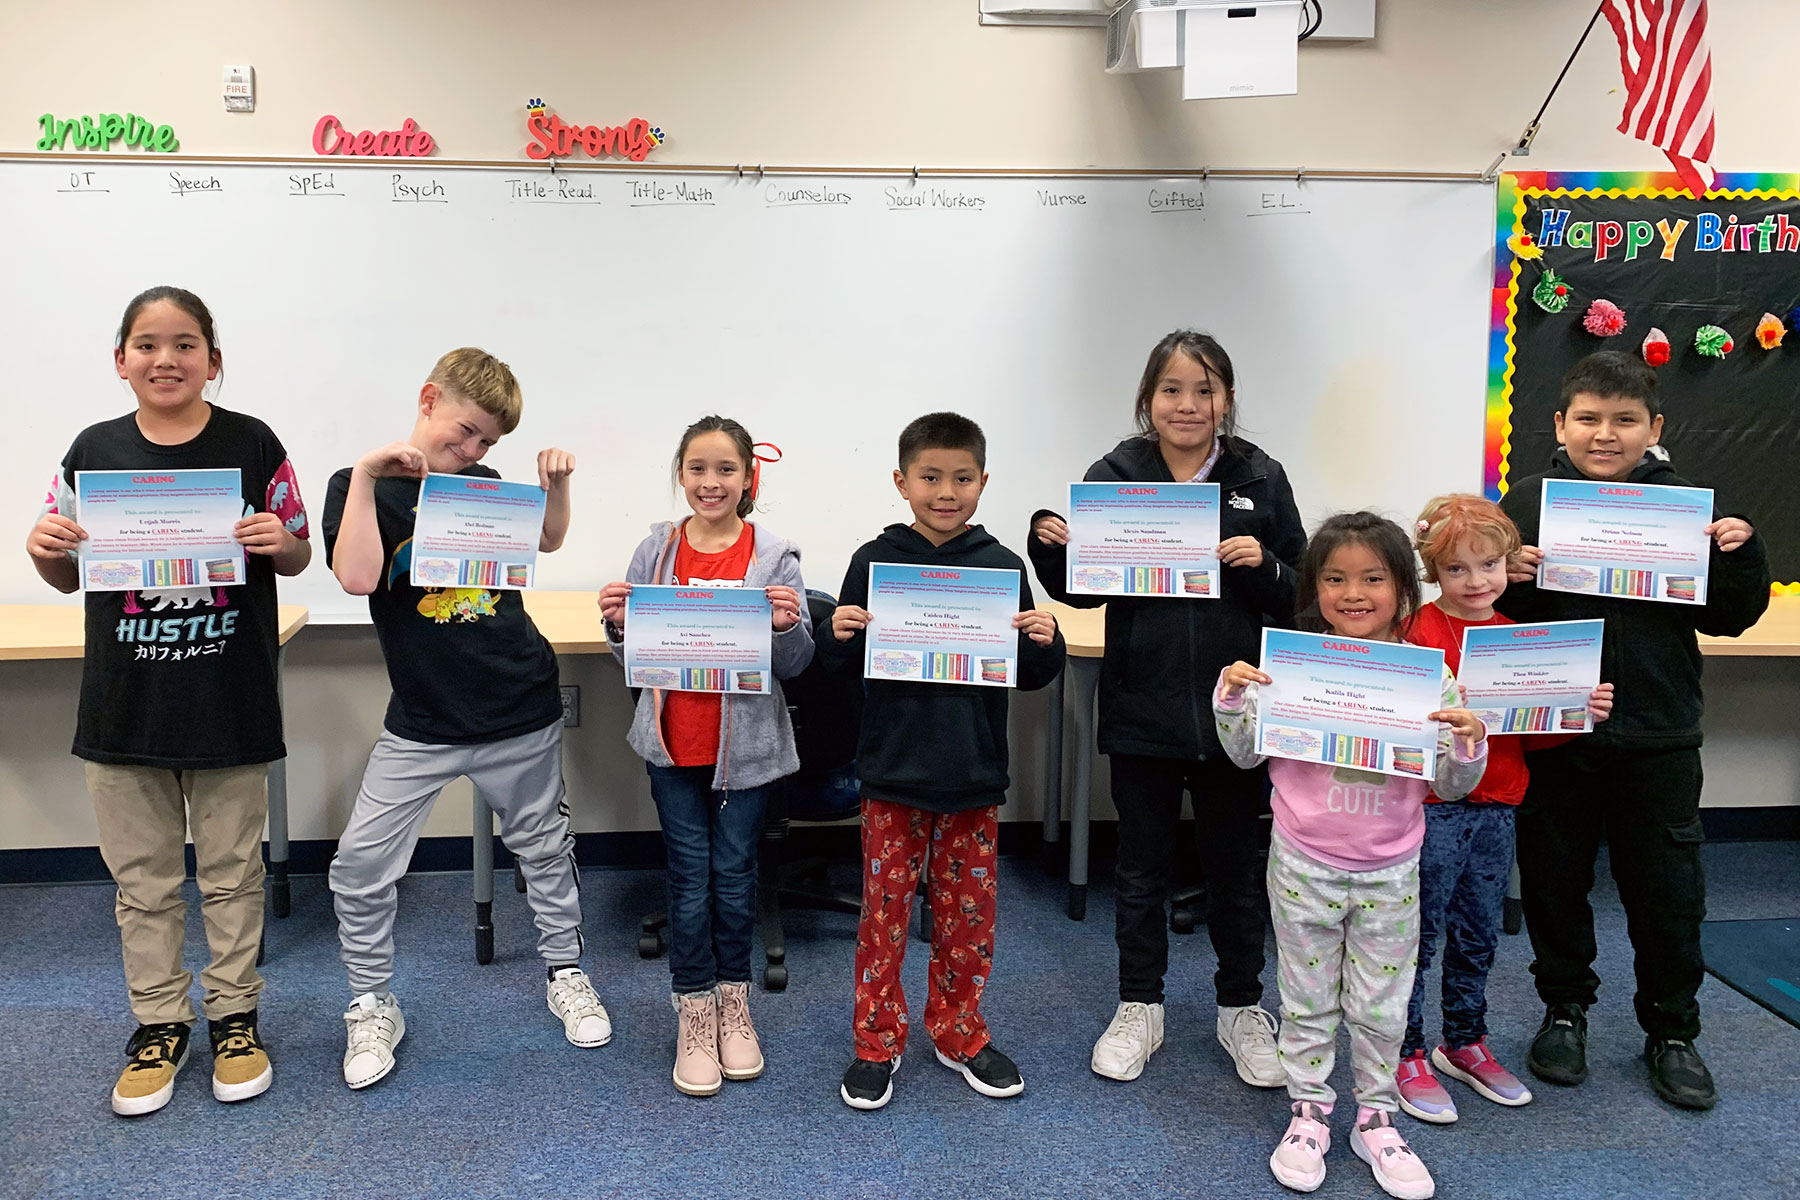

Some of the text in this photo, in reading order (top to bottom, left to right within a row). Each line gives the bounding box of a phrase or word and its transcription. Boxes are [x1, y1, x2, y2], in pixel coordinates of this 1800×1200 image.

[37, 113, 180, 152] Inspire
[312, 114, 434, 156] Create
[526, 114, 650, 162] Strong
[169, 171, 220, 196] Speech
[289, 173, 335, 195] SpEd
[392, 174, 445, 202] Psych
[626, 180, 713, 201] Title-Math
[765, 183, 852, 204] Counselors
[885, 185, 986, 208] Social Workers
[1148, 189, 1205, 209] Gifted
[1538, 208, 1800, 263] Happy Birth
[466, 482, 499, 490] CARING
[1599, 487, 1643, 496] CARING
[921, 571, 960, 579] CARING
[116, 610, 239, 642] HUSTLE
[1513, 629, 1549, 638] CARING
[1322, 642, 1370, 654] CARING
[1338, 701, 1368, 710] CARING
[1328, 785, 1385, 816] CUTE
